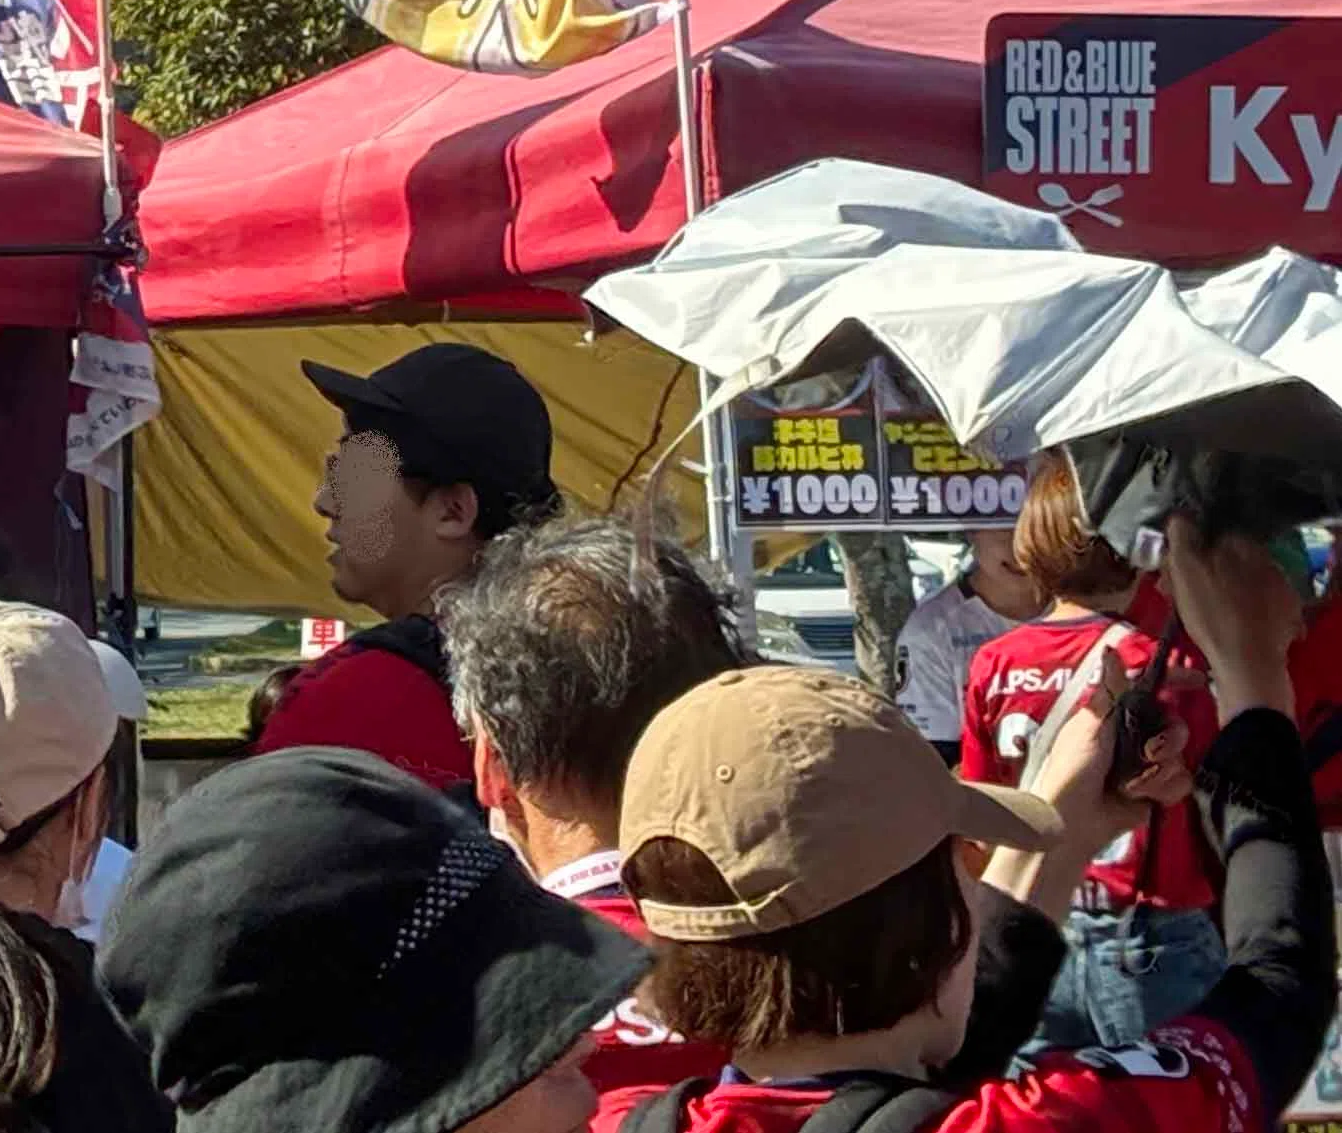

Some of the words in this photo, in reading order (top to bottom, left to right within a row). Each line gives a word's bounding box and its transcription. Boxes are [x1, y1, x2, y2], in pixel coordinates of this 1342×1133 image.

[1005, 39, 1156, 94] RED&BLUE
[1005, 96, 1156, 175] STREET
[742, 474, 879, 515] ¥1000
[889, 474, 1026, 516] ¥1000
